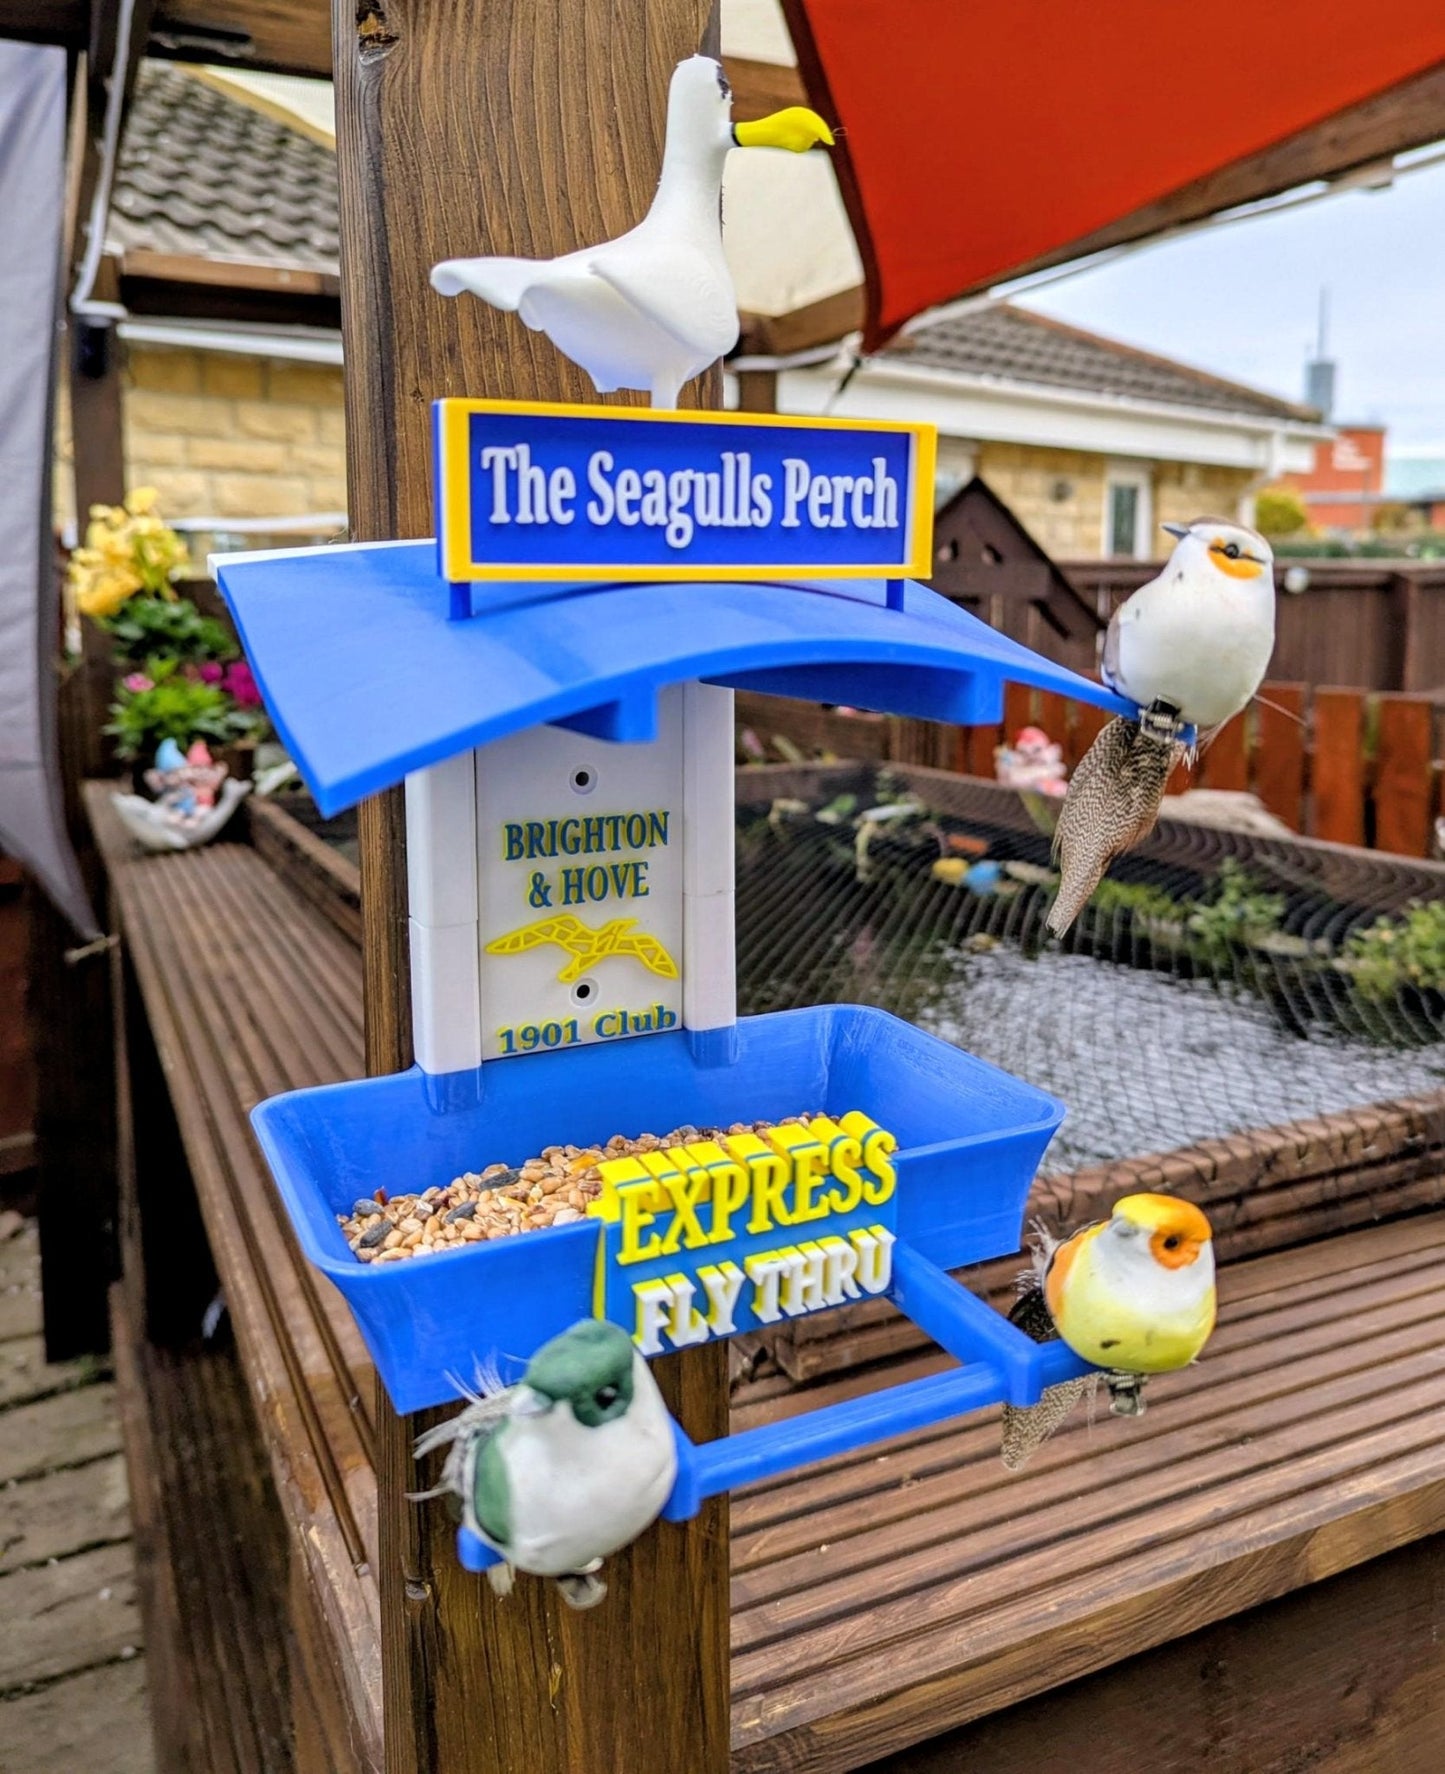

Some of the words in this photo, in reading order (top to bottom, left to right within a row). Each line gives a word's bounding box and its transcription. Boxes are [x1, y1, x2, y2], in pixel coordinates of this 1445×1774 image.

[481, 443, 576, 525] The
[587, 450, 773, 549] Seagulls
[782, 457, 899, 529] Perch
[504, 811, 670, 861] BRIGHTON
[528, 871, 552, 908] &
[561, 861, 650, 905] HOVE
[498, 1018, 582, 1054] 1901
[594, 1005, 677, 1039] Club
[612, 1119, 897, 1266] EXPRESS
